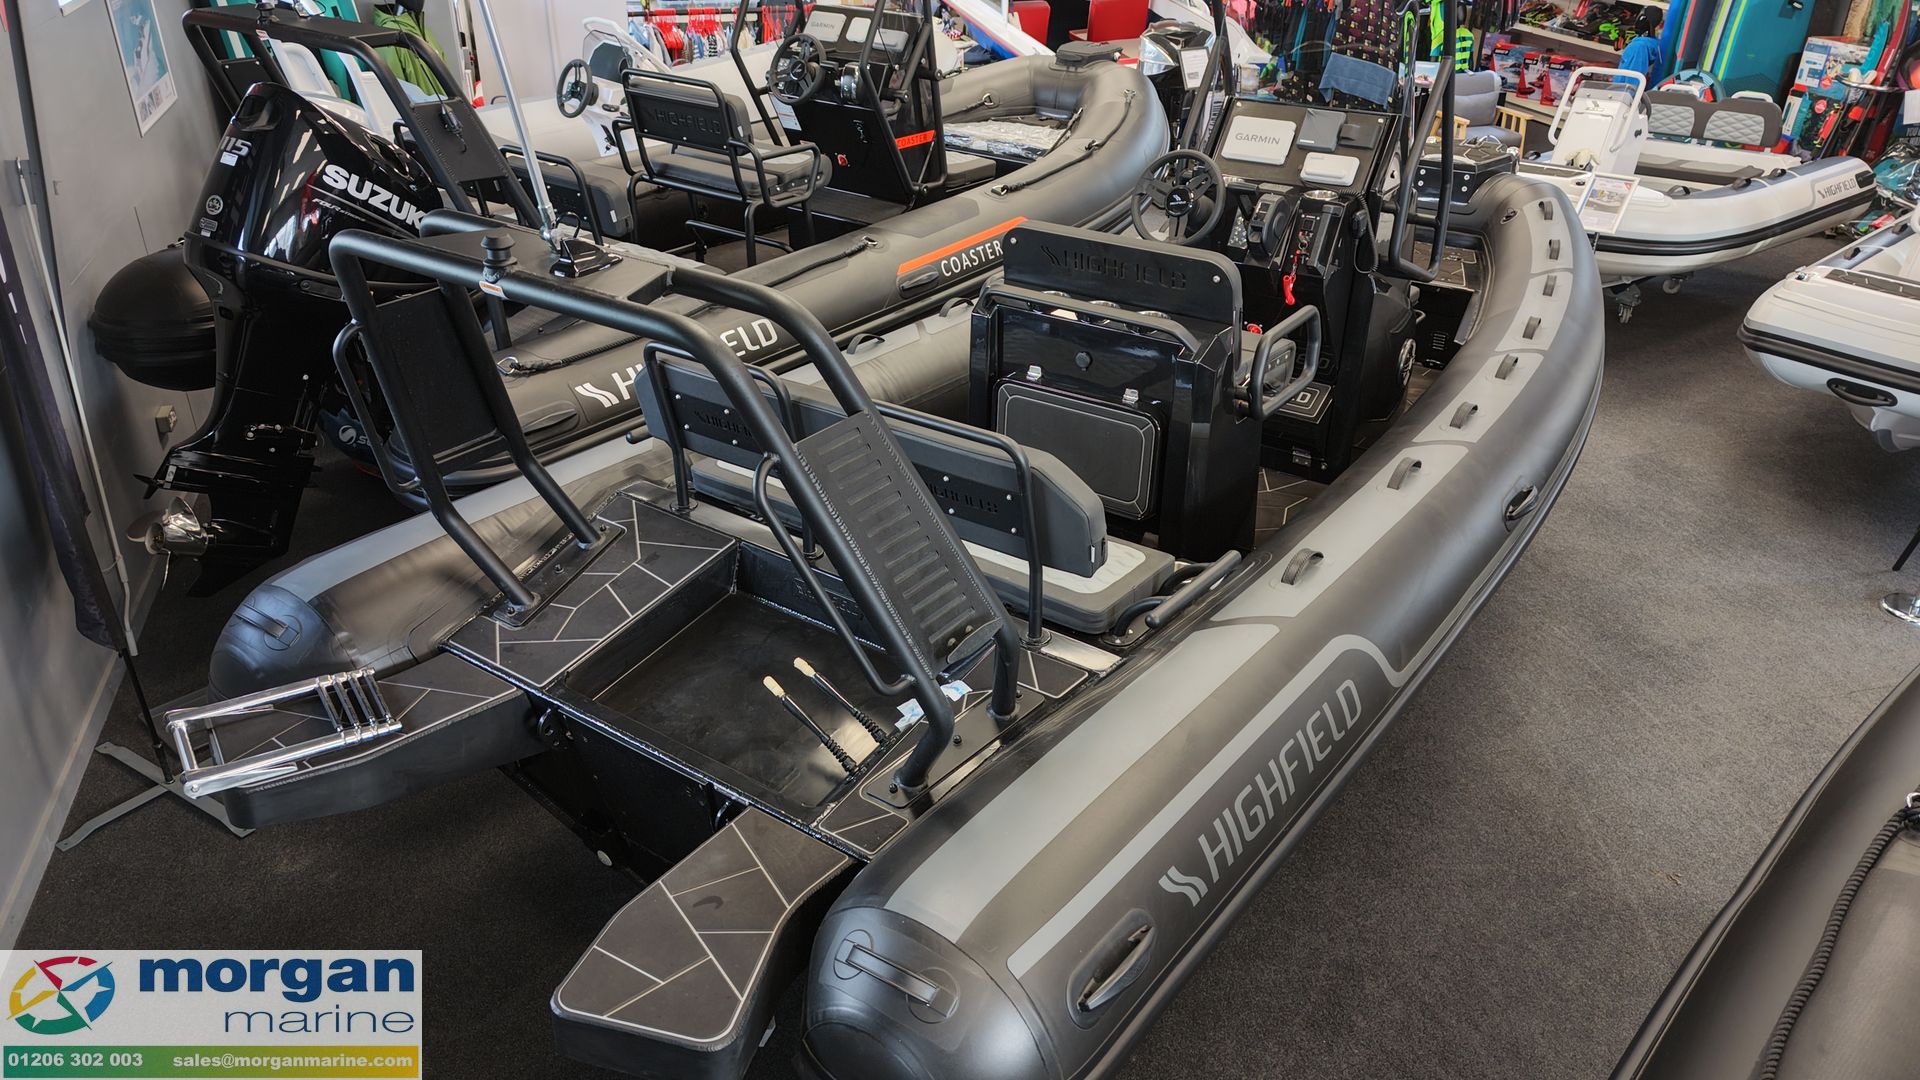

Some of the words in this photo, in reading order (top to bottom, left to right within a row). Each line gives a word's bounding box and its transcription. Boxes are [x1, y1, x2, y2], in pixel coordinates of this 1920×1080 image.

[220, 135, 252, 156] 115
[1234, 132, 1281, 146] GARMIN
[322, 164, 427, 230] SUZUK
[1824, 178, 1857, 198] HIGHFIELD
[940, 240, 1004, 277] COASTER
[1063, 249, 1187, 290] HIGHFIELD
[1197, 679, 1362, 884] HIGHFIELD
